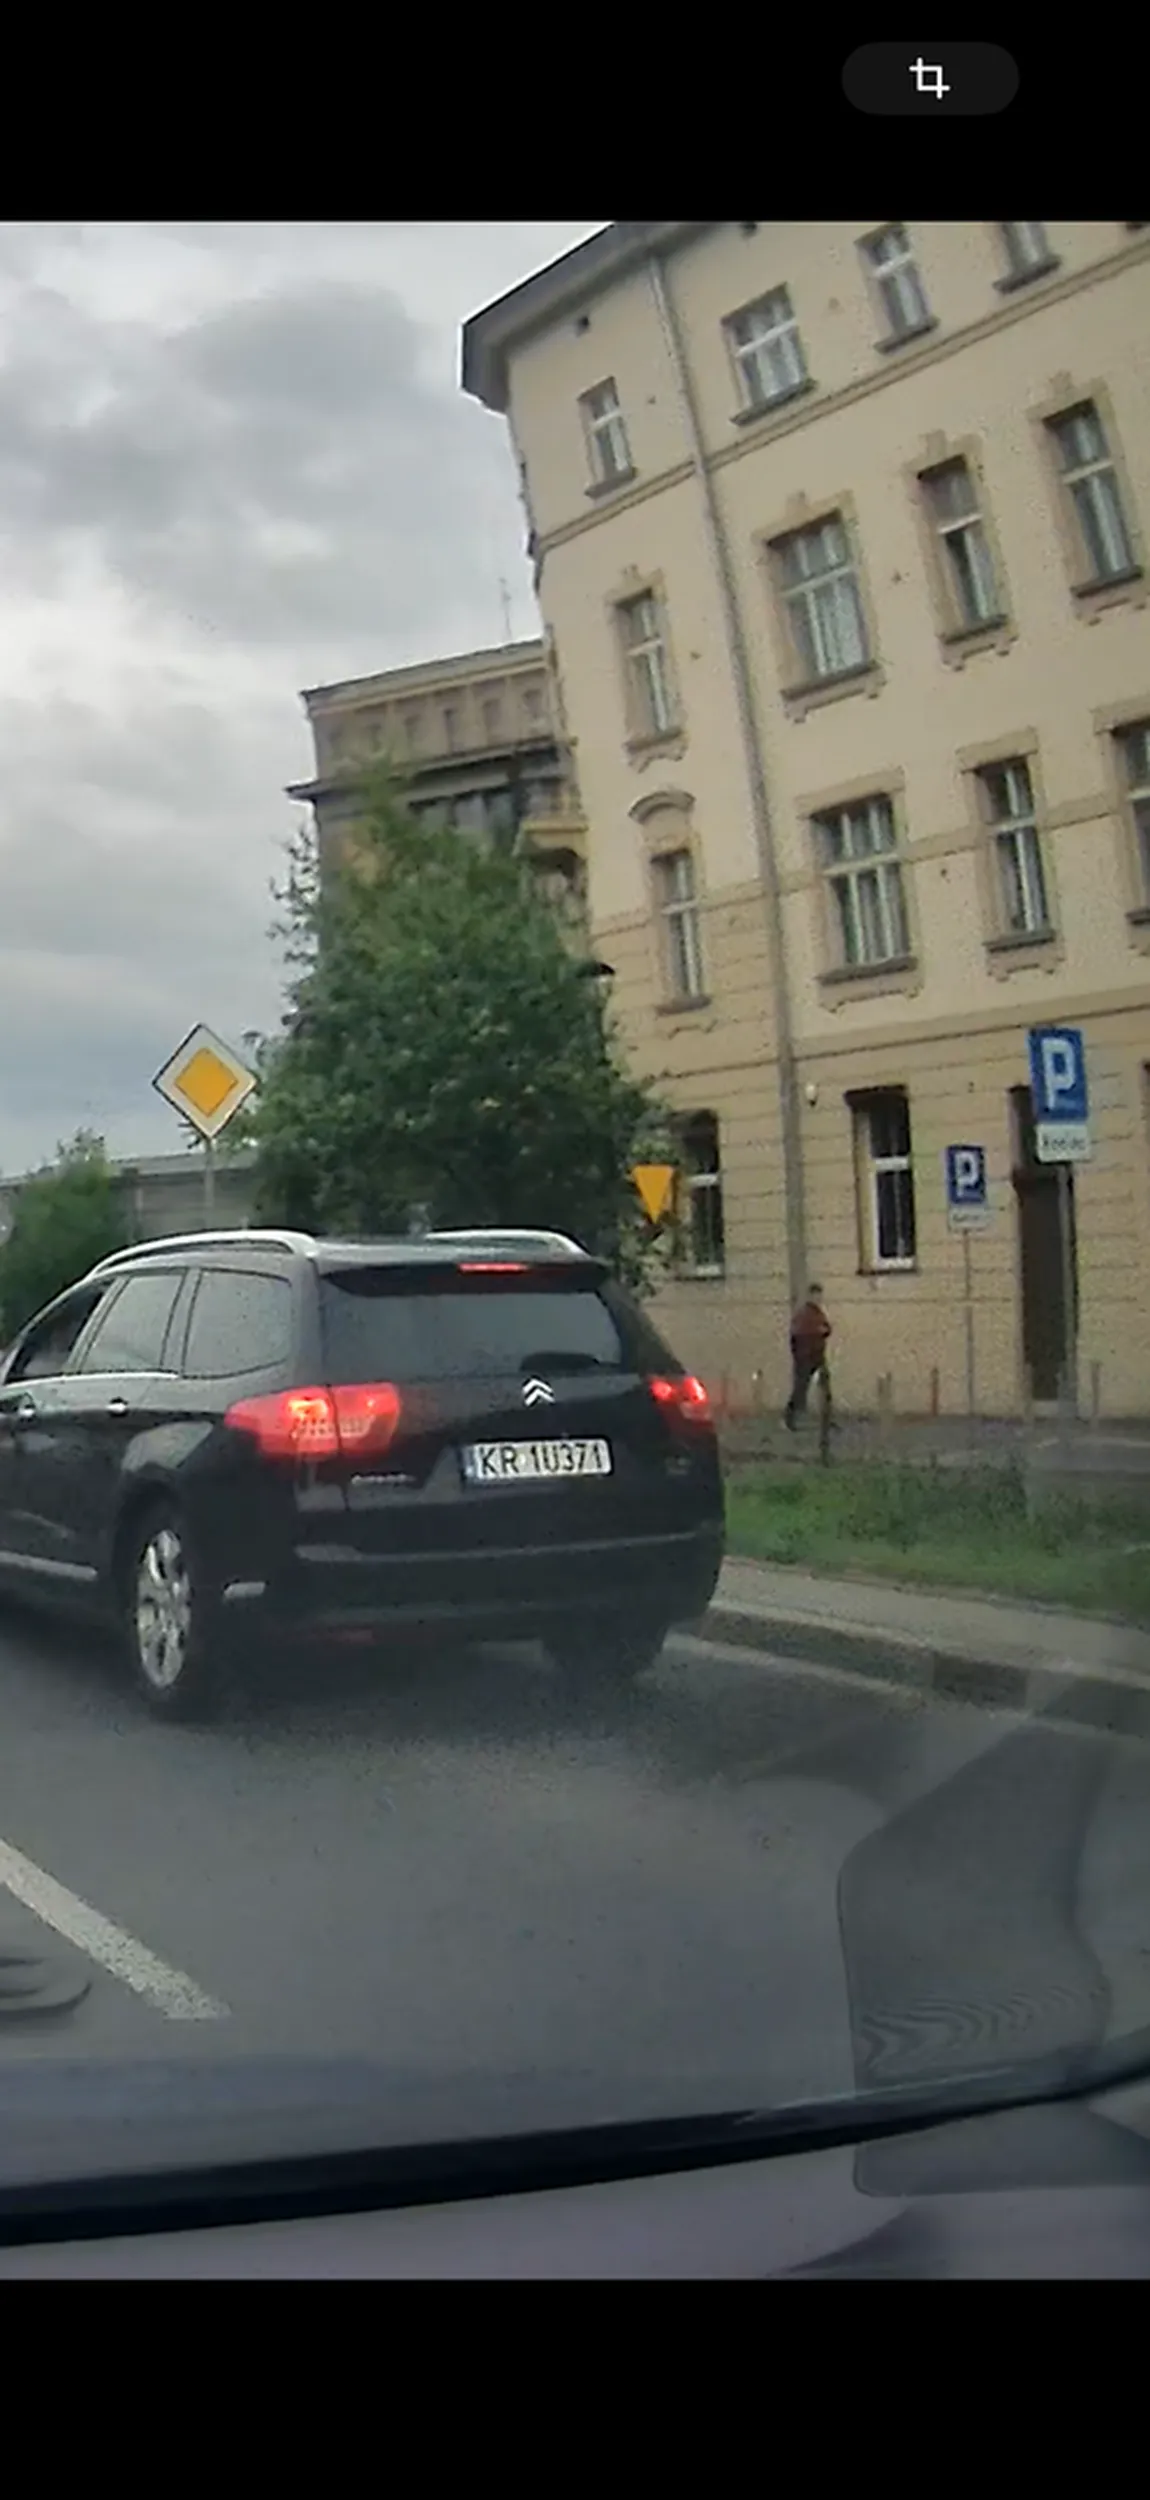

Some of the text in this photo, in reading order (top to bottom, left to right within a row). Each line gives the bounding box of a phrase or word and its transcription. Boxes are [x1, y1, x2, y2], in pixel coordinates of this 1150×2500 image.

[1041, 1037, 1076, 1110] P
[954, 1149, 979, 1198] P
[479, 1443, 602, 1475] KR 1U371
